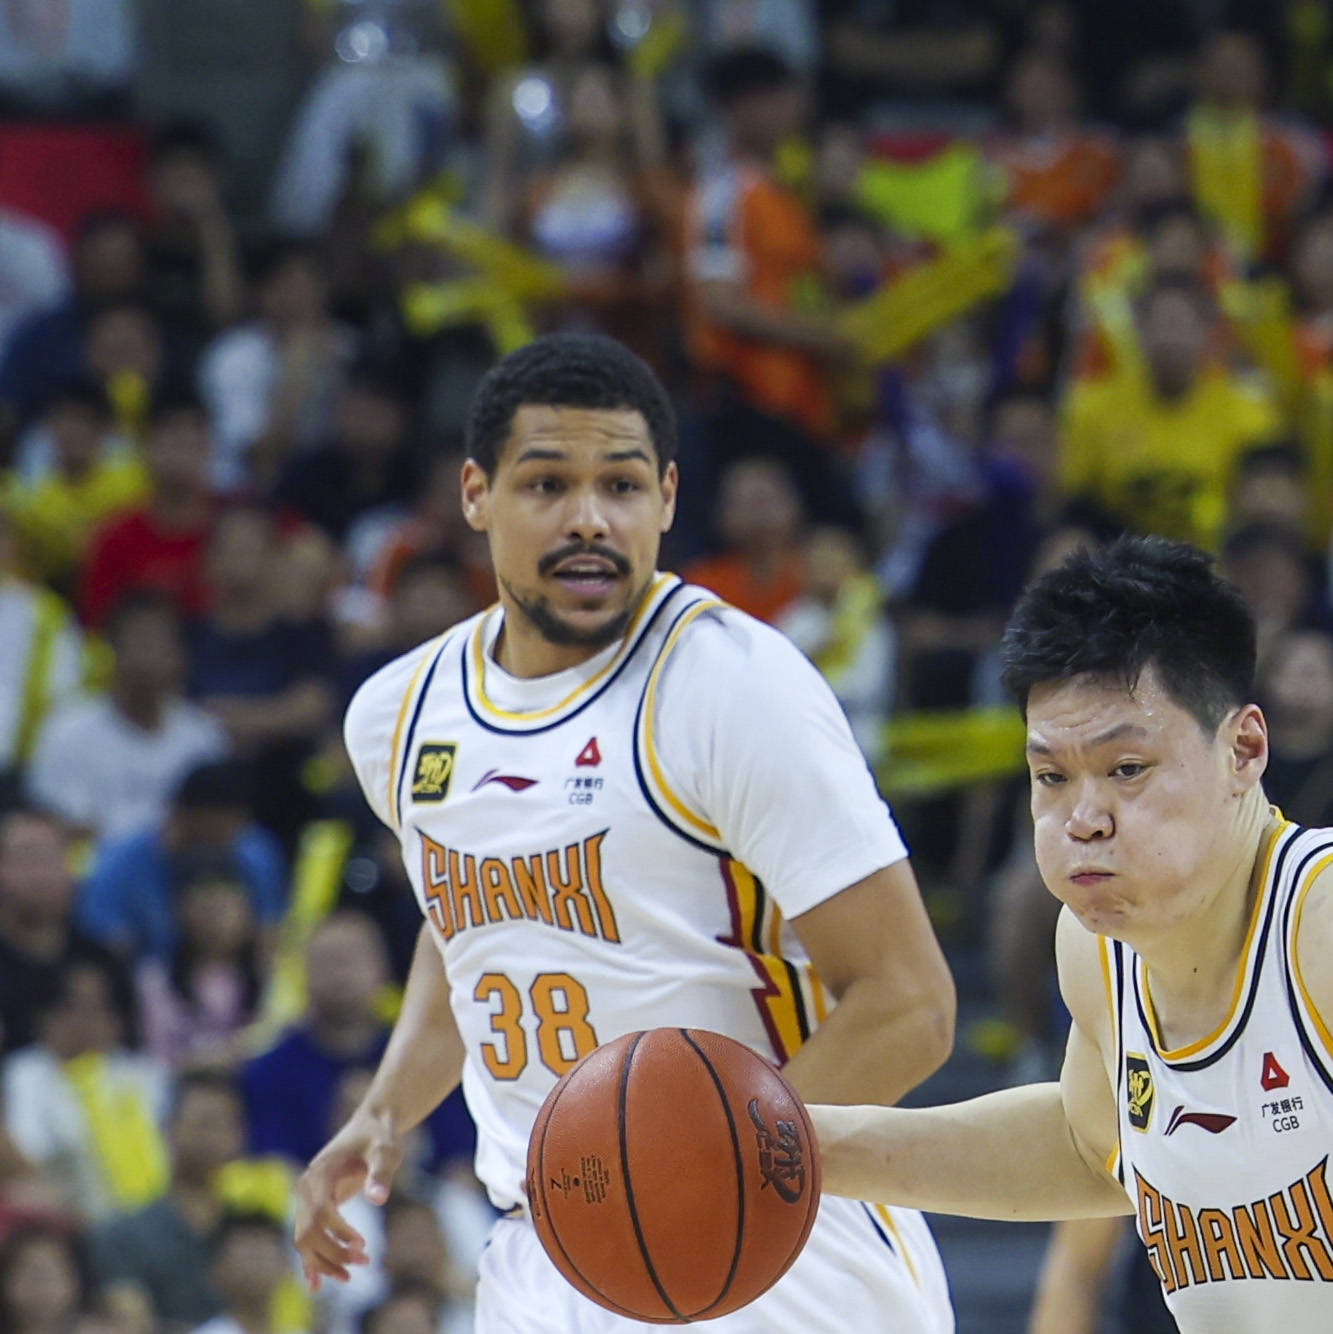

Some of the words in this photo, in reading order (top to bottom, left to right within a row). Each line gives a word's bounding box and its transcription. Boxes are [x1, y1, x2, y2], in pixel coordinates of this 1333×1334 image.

[569, 792, 593, 806] CGB
[414, 826, 621, 943] SHANXI
[473, 972, 599, 1081] 38
[1261, 1096, 1304, 1118] 广发银行
[1272, 1115, 1300, 1133] CGB
